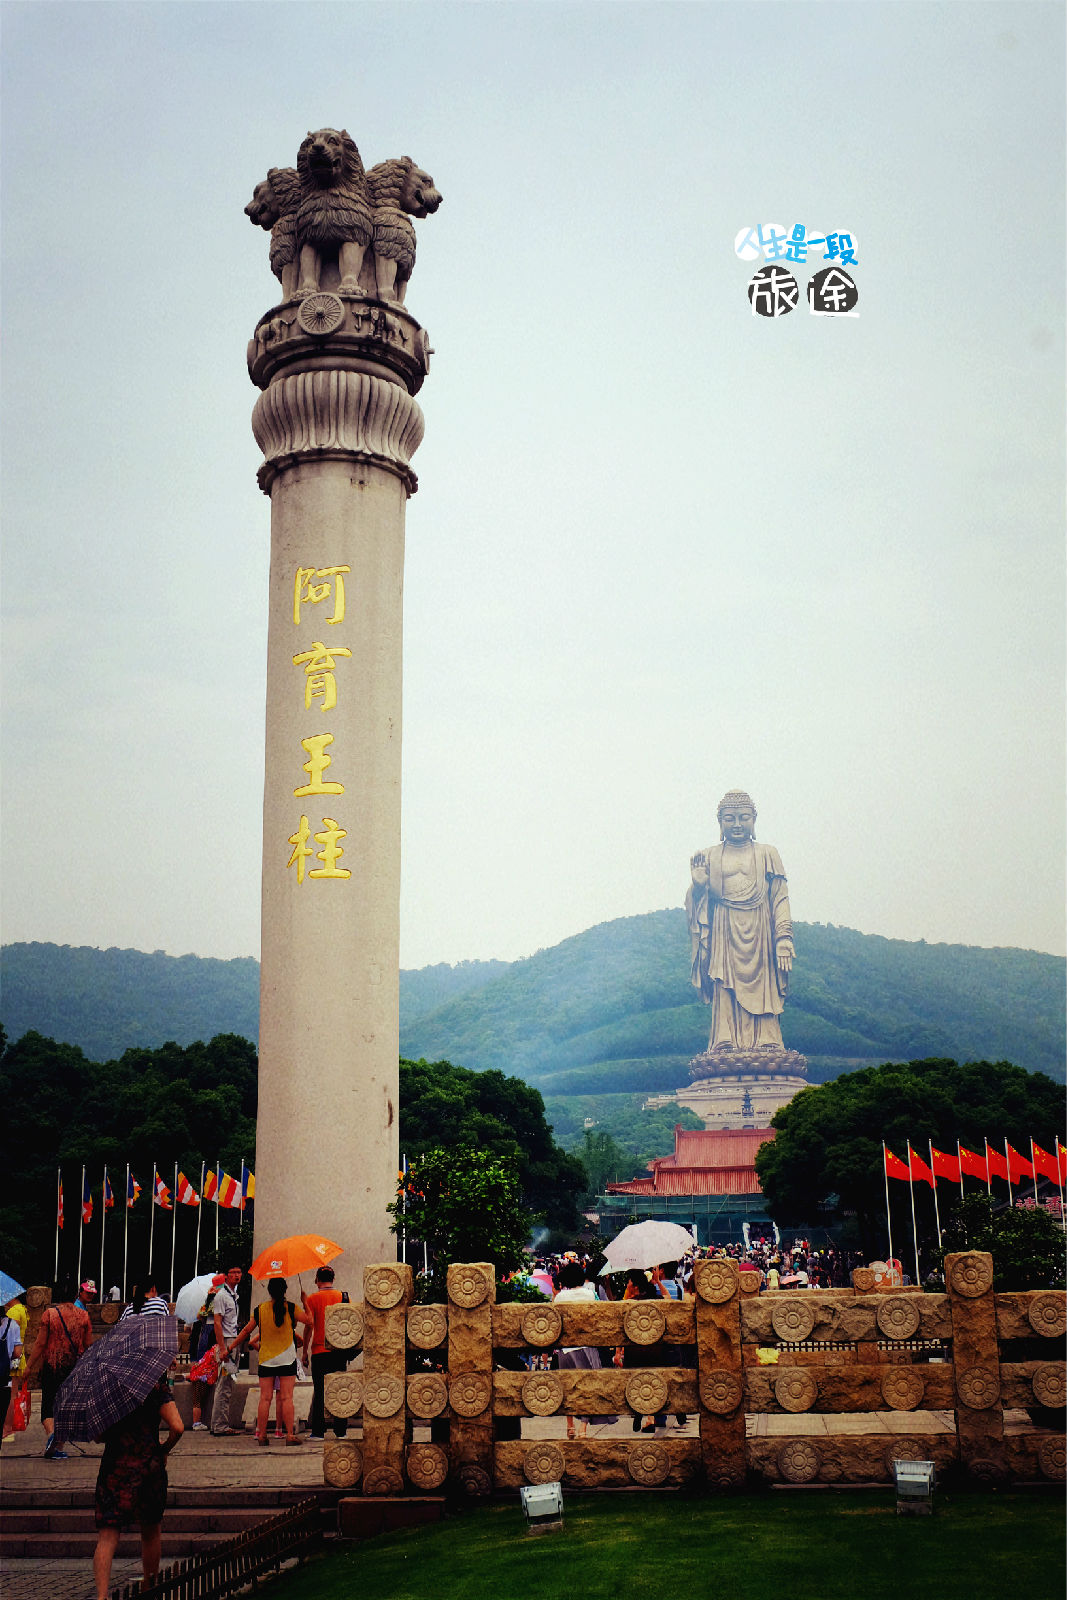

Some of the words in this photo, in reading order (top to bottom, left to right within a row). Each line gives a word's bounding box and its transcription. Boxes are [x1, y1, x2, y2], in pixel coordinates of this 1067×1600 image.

[286, 564, 353, 885] 阿育王柱
[1015, 1196, 1067, 1217] 请香
